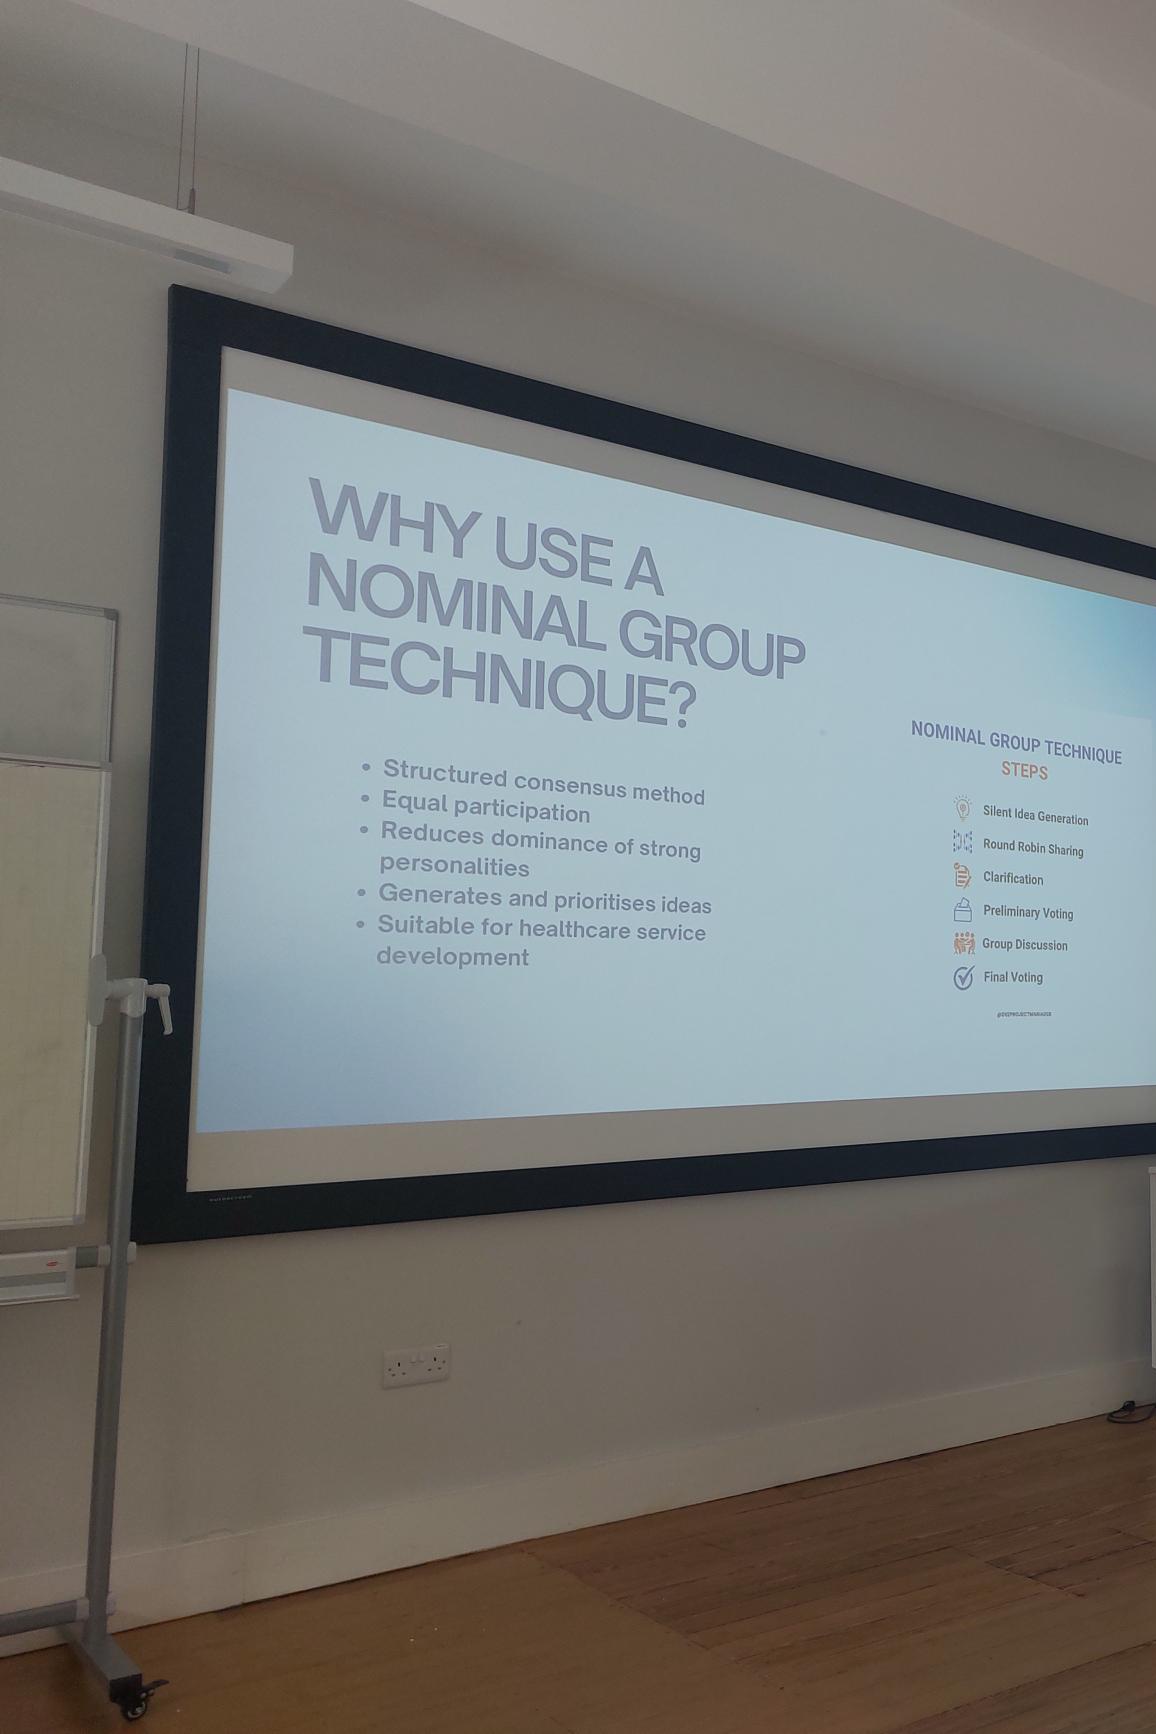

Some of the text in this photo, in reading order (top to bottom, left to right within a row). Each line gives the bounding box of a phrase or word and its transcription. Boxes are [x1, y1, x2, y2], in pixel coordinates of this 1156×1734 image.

[308, 477, 665, 596] WHY USE A
[308, 551, 806, 679] NOMINAL GROUP
[302, 625, 697, 728] TECHNIQUE?
[911, 720, 1123, 765] NOMINAL GROUP TECHNIQUE
[383, 758, 706, 806] Structured consensus method
[1001, 761, 1048, 780] STEPS
[382, 790, 591, 824] Equal participation
[983, 805, 1089, 826] Silent Idea Generation
[381, 820, 702, 863] Reduces dominance of strong
[983, 838, 1084, 859] Round Robin Sharing
[379, 853, 530, 877] personalities
[983, 870, 1044, 885] Clarification
[378, 883, 712, 914] Generates and prioritises ideas
[983, 904, 1074, 922] Preliminary Voting
[378, 914, 707, 941] Suitable for healthcare service
[376, 946, 530, 969] development
[982, 938, 1068, 952] Group Discussion
[984, 971, 1043, 985] Final Voting
